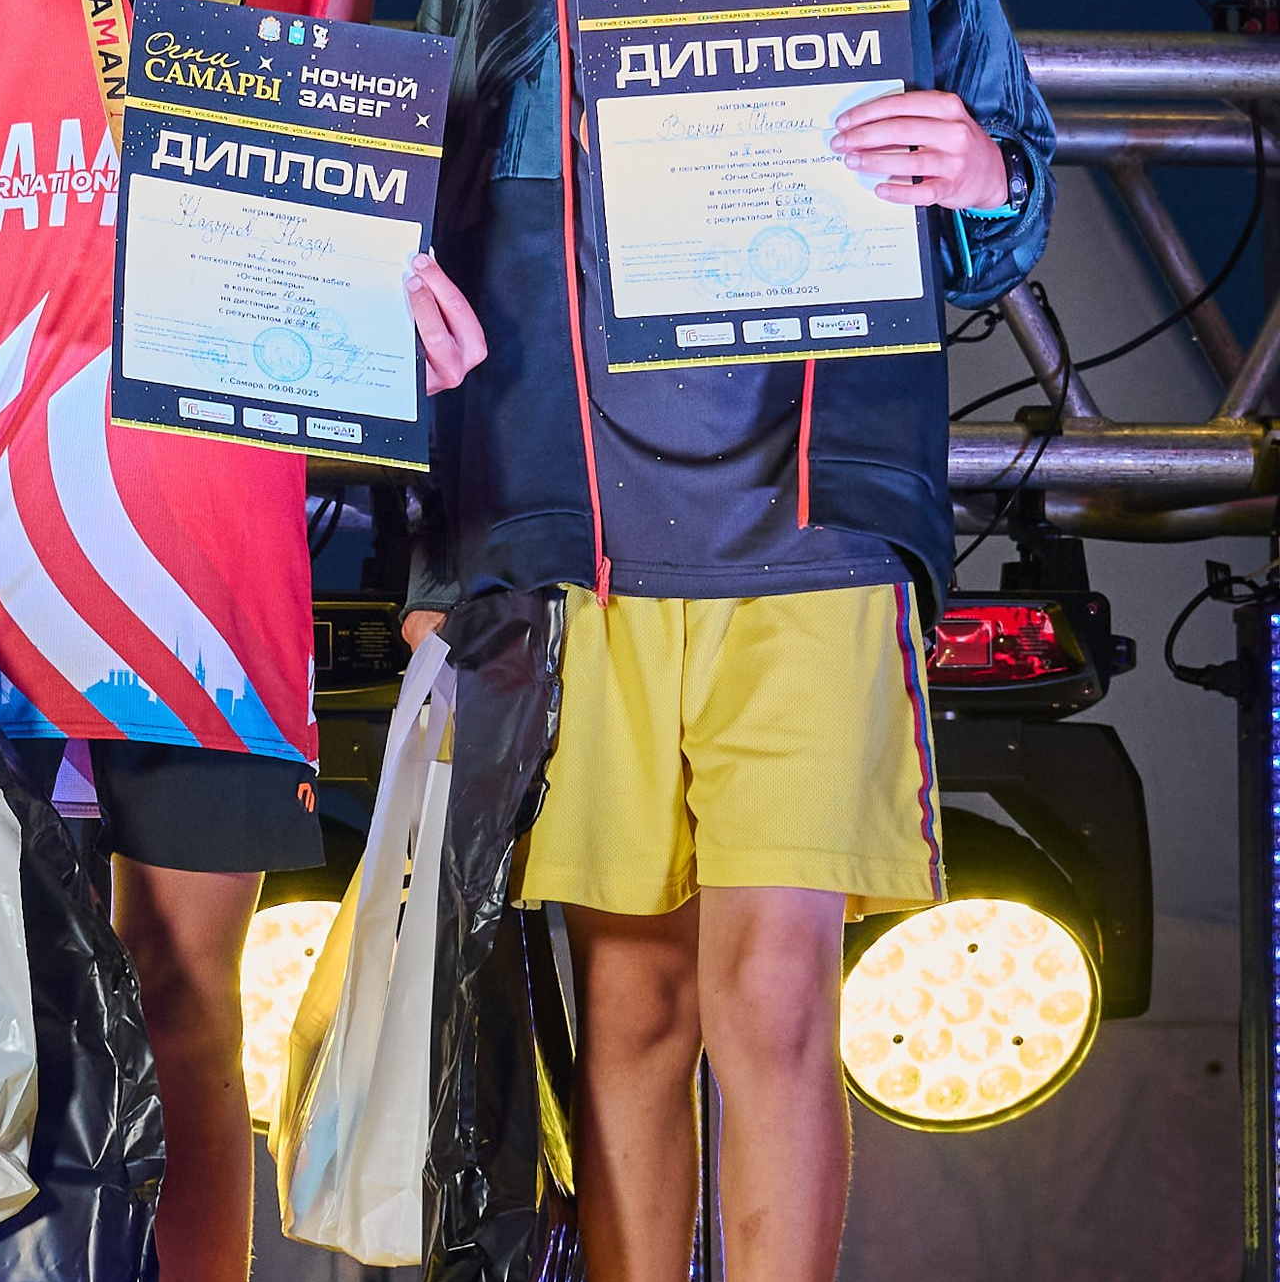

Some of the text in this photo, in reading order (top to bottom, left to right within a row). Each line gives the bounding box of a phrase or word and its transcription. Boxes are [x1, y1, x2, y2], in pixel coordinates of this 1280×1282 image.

[144, 31, 240, 68] Огни
[616, 30, 882, 89] ДИПЛОМ
[144, 57, 282, 102] САМАРЫ
[301, 65, 418, 101] НОЧНОЙ
[298, 89, 391, 118] ЗАБЕГ
[151, 129, 409, 205] ДИПЛОМ
[271, 256, 297, 268] место
[286, 270, 319, 283] ночном
[232, 286, 277, 299] категории
[766, 285, 820, 296] 09.08.2025
[233, 297, 280, 312] дистанции
[225, 310, 282, 324] результатом
[816, 319, 860, 329] NaviGAR
[268, 383, 320, 398] 09.08.2025
[313, 422, 355, 434] NaviGAR
